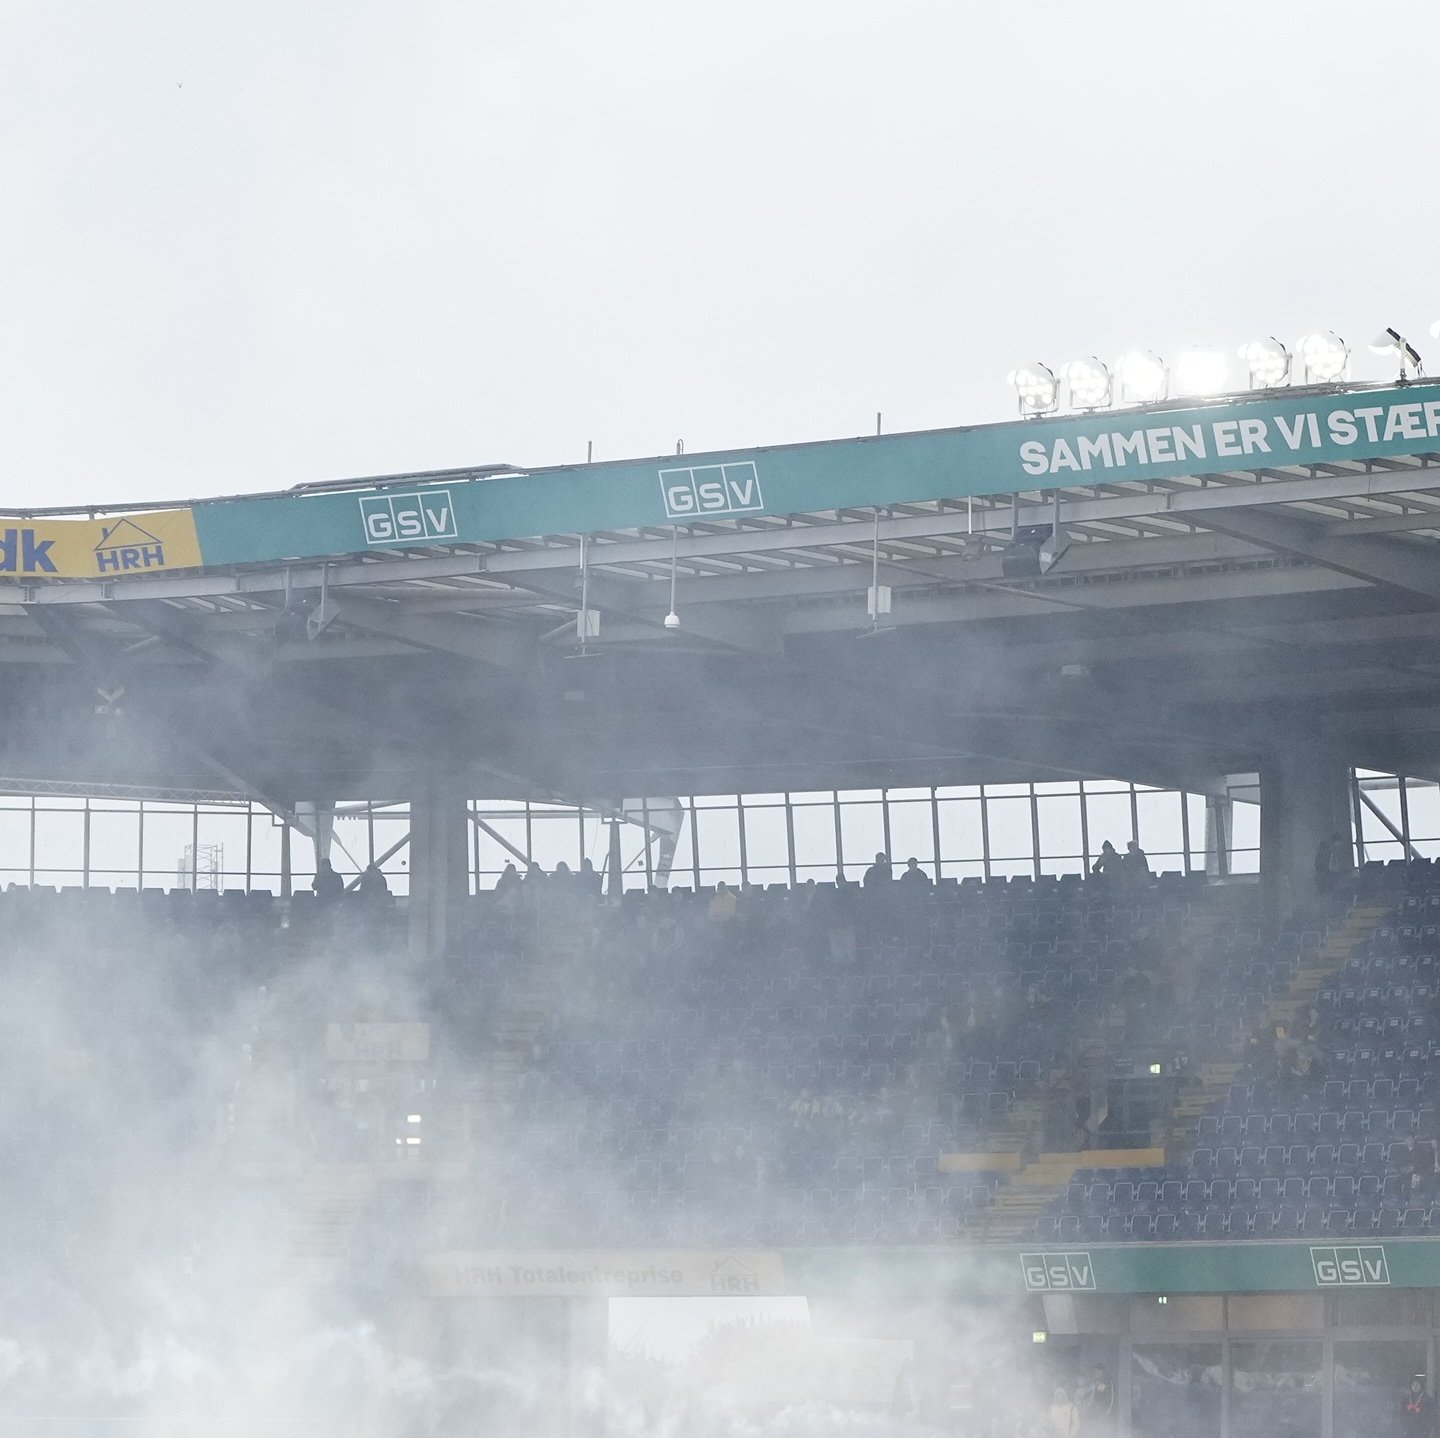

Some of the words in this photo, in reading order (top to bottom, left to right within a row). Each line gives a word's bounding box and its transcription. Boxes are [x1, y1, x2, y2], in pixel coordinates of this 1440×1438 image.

[1021, 426, 1206, 475] SAMMEN
[1213, 419, 1270, 455] ER
[1273, 413, 1322, 450] VI
[666, 481, 754, 513] GSV
[367, 507, 449, 540] GSV
[95, 545, 164, 573] HRH
[712, 1275, 759, 1292] HRH
[1026, 1268, 1091, 1289] GSV
[1318, 1260, 1383, 1283] GSV
